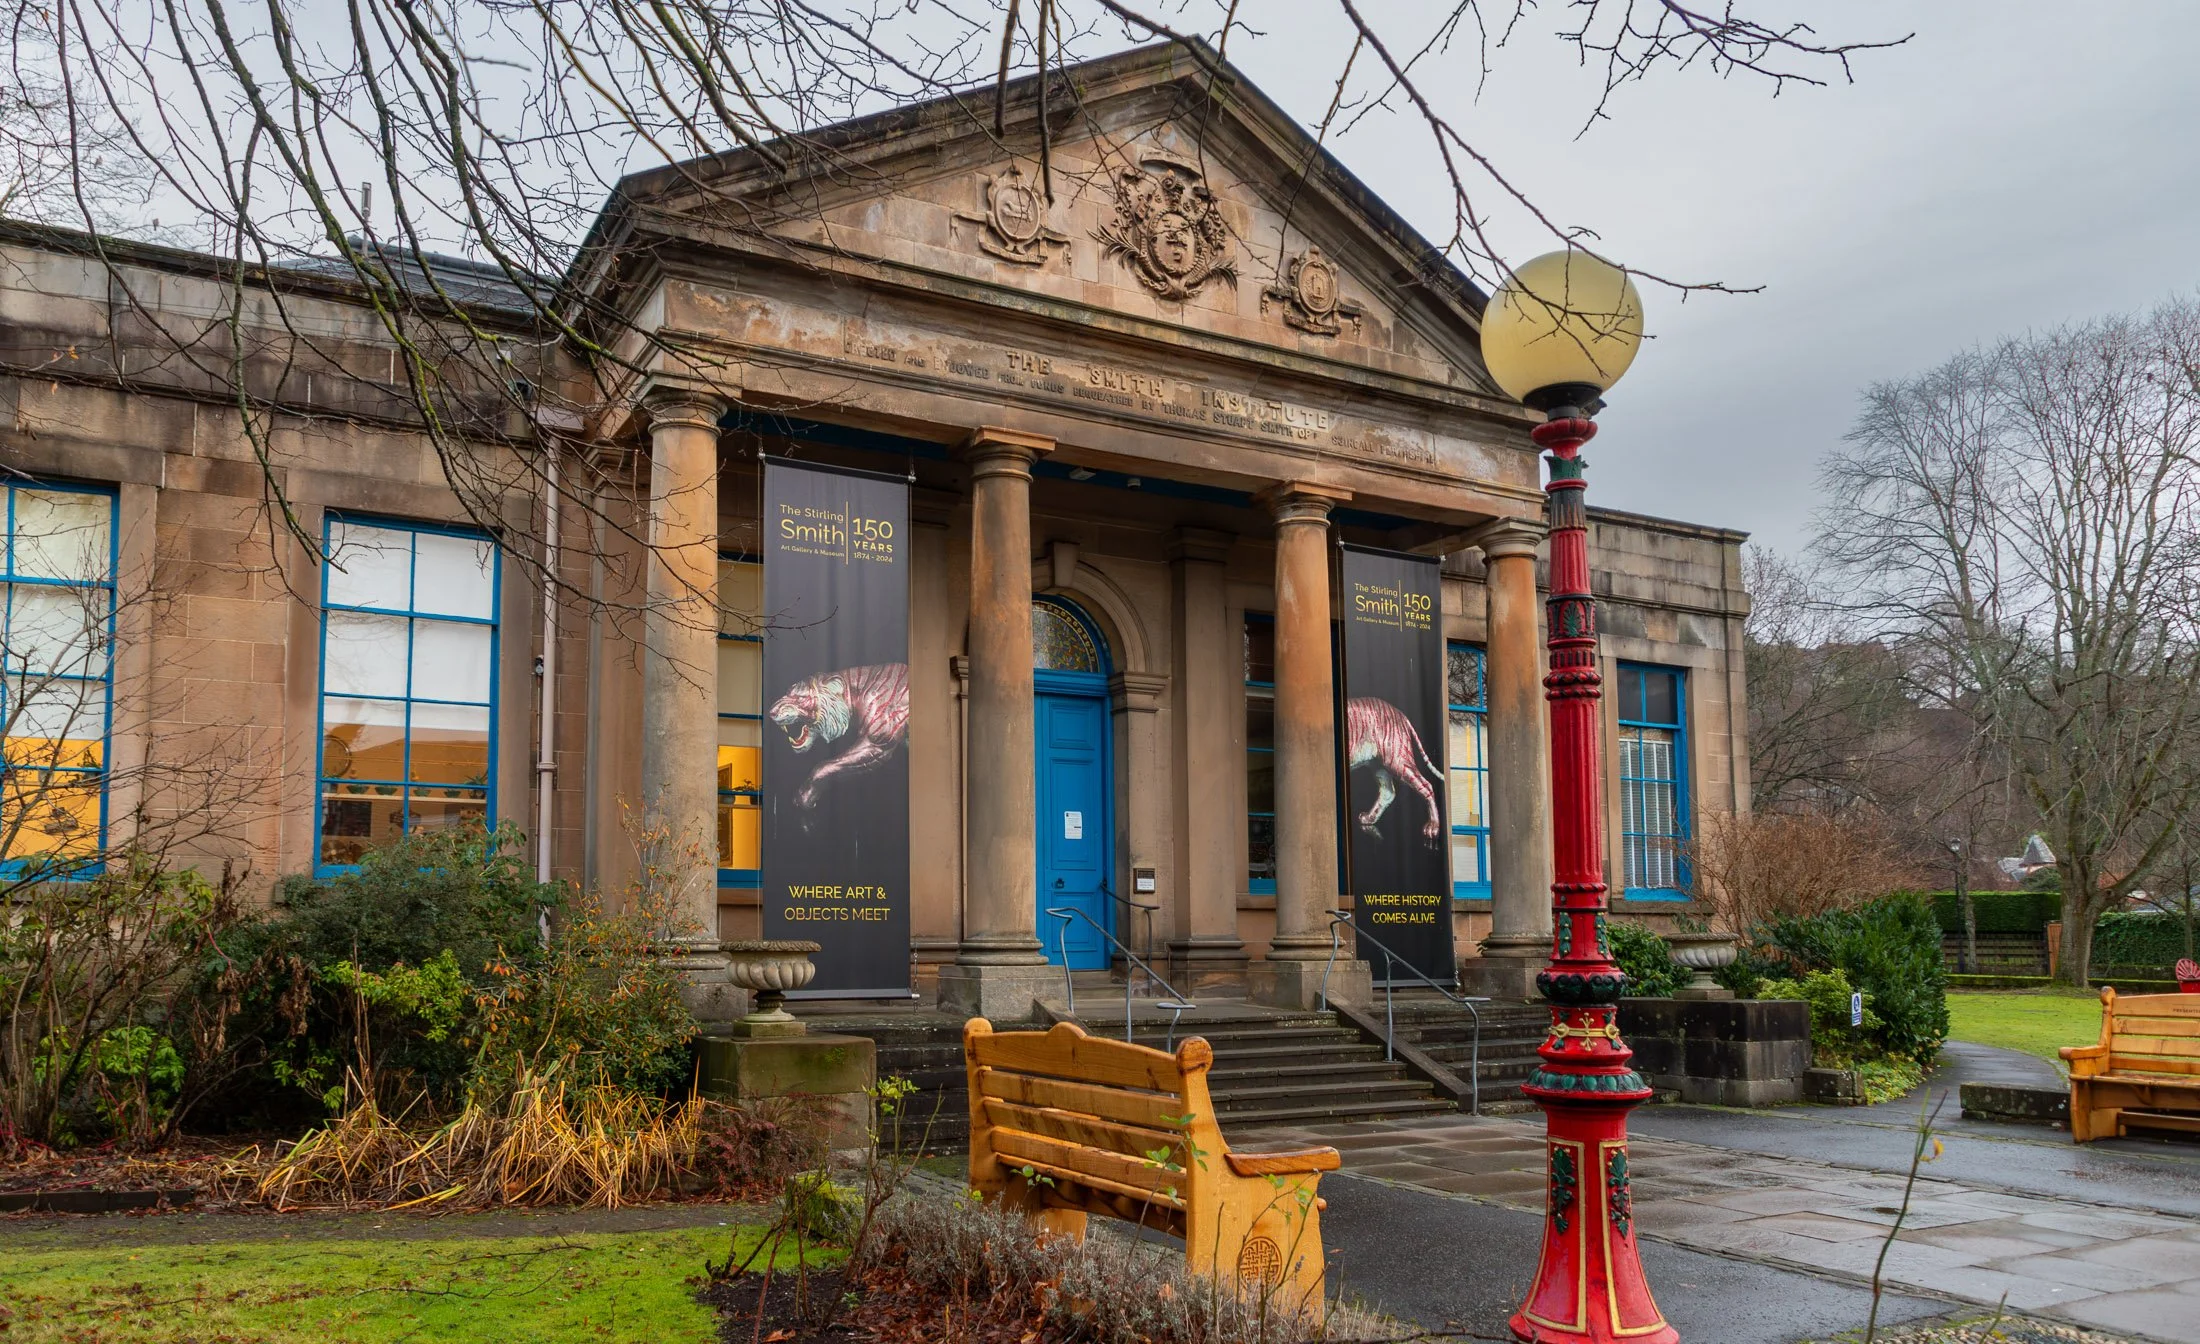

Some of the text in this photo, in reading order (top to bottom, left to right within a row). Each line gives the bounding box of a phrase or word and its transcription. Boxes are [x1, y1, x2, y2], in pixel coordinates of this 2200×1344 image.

[904, 354, 927, 368] AND
[997, 373, 1024, 387] FROM
[1031, 379, 1065, 394] FUNDS
[1073, 387, 1133, 407] BEQUEATHED
[1142, 400, 1154, 411] BY
[1162, 403, 1207, 421] THOMAS
[1213, 413, 1255, 430] STUART
[1261, 421, 1294, 438] SMITH
[1006, 351, 1328, 429] THE SMITH INSTITUTE
[780, 504, 844, 524] The Stirling
[780, 518, 844, 546] Smith
[852, 517, 893, 541] 150
[791, 546, 813, 555] Gallery
[820, 549, 845, 558] Museum
[853, 540, 893, 553] YEARS
[853, 552, 870, 561] 1874
[875, 554, 893, 563] 2024
[1354, 583, 1398, 598] The Stirling
[1355, 595, 1399, 617] Smith
[1403, 593, 1431, 612] 150
[1404, 611, 1431, 622] YEARS
[788, 885, 886, 899] WHERE ART &
[1363, 894, 1441, 906] WHERE HISTORY
[784, 907, 891, 921] OBJECTS MEET
[1372, 912, 1435, 924] COMES ALIVE
